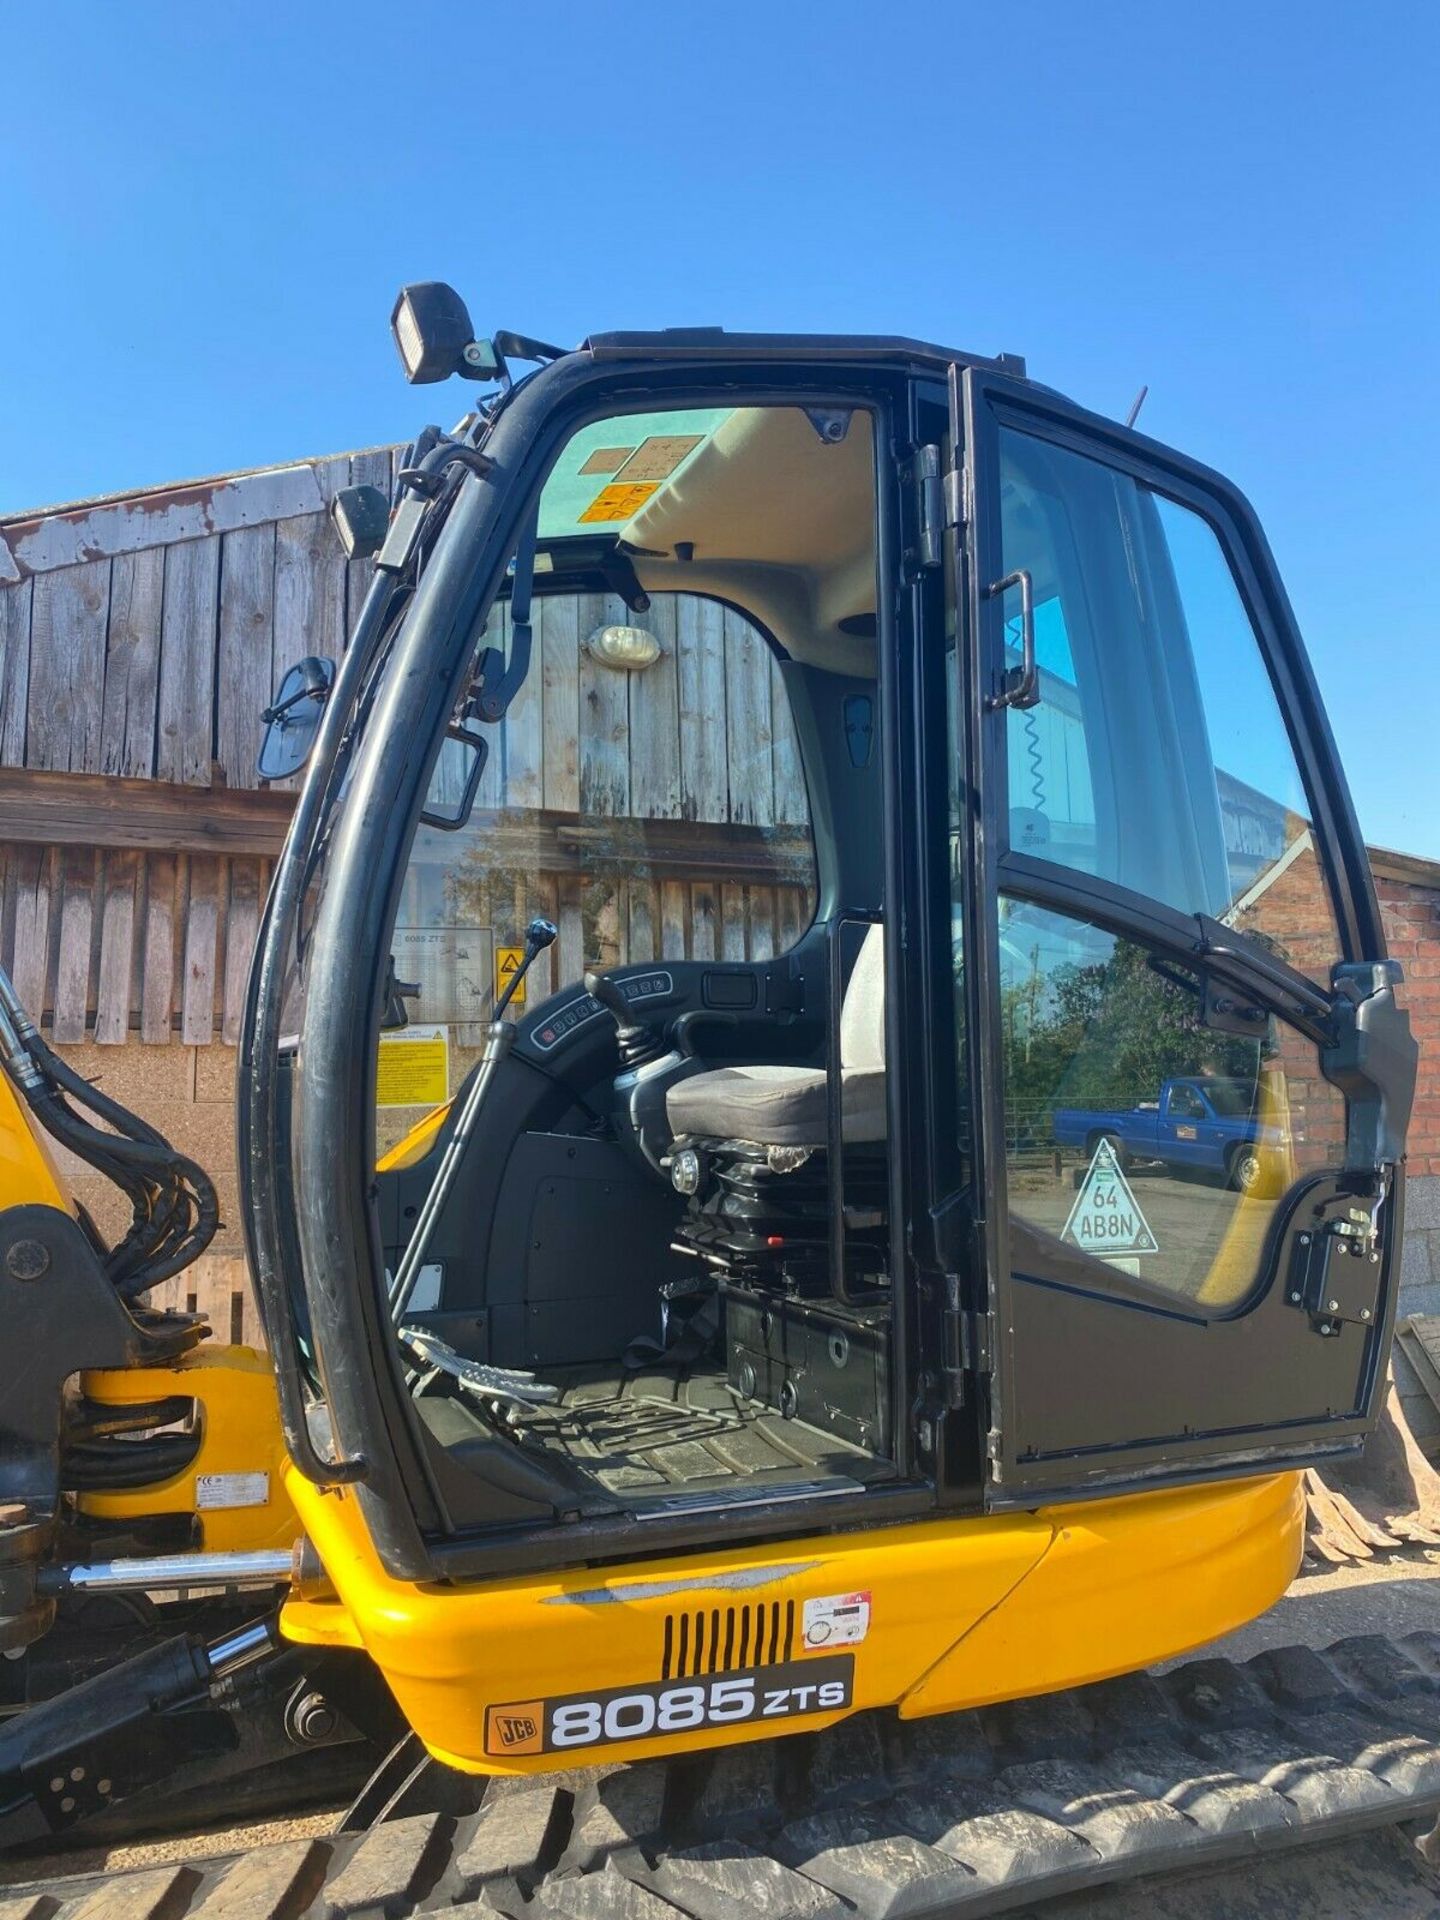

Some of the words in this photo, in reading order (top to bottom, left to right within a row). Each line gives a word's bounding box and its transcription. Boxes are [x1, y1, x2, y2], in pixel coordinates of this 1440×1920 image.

[1093, 1185, 1118, 1209] 64
[1081, 1213, 1133, 1239] AB8N
[503, 1717, 536, 1744] JCB
[551, 1677, 755, 1747] 8085
[763, 1681, 845, 1715] ZTS
